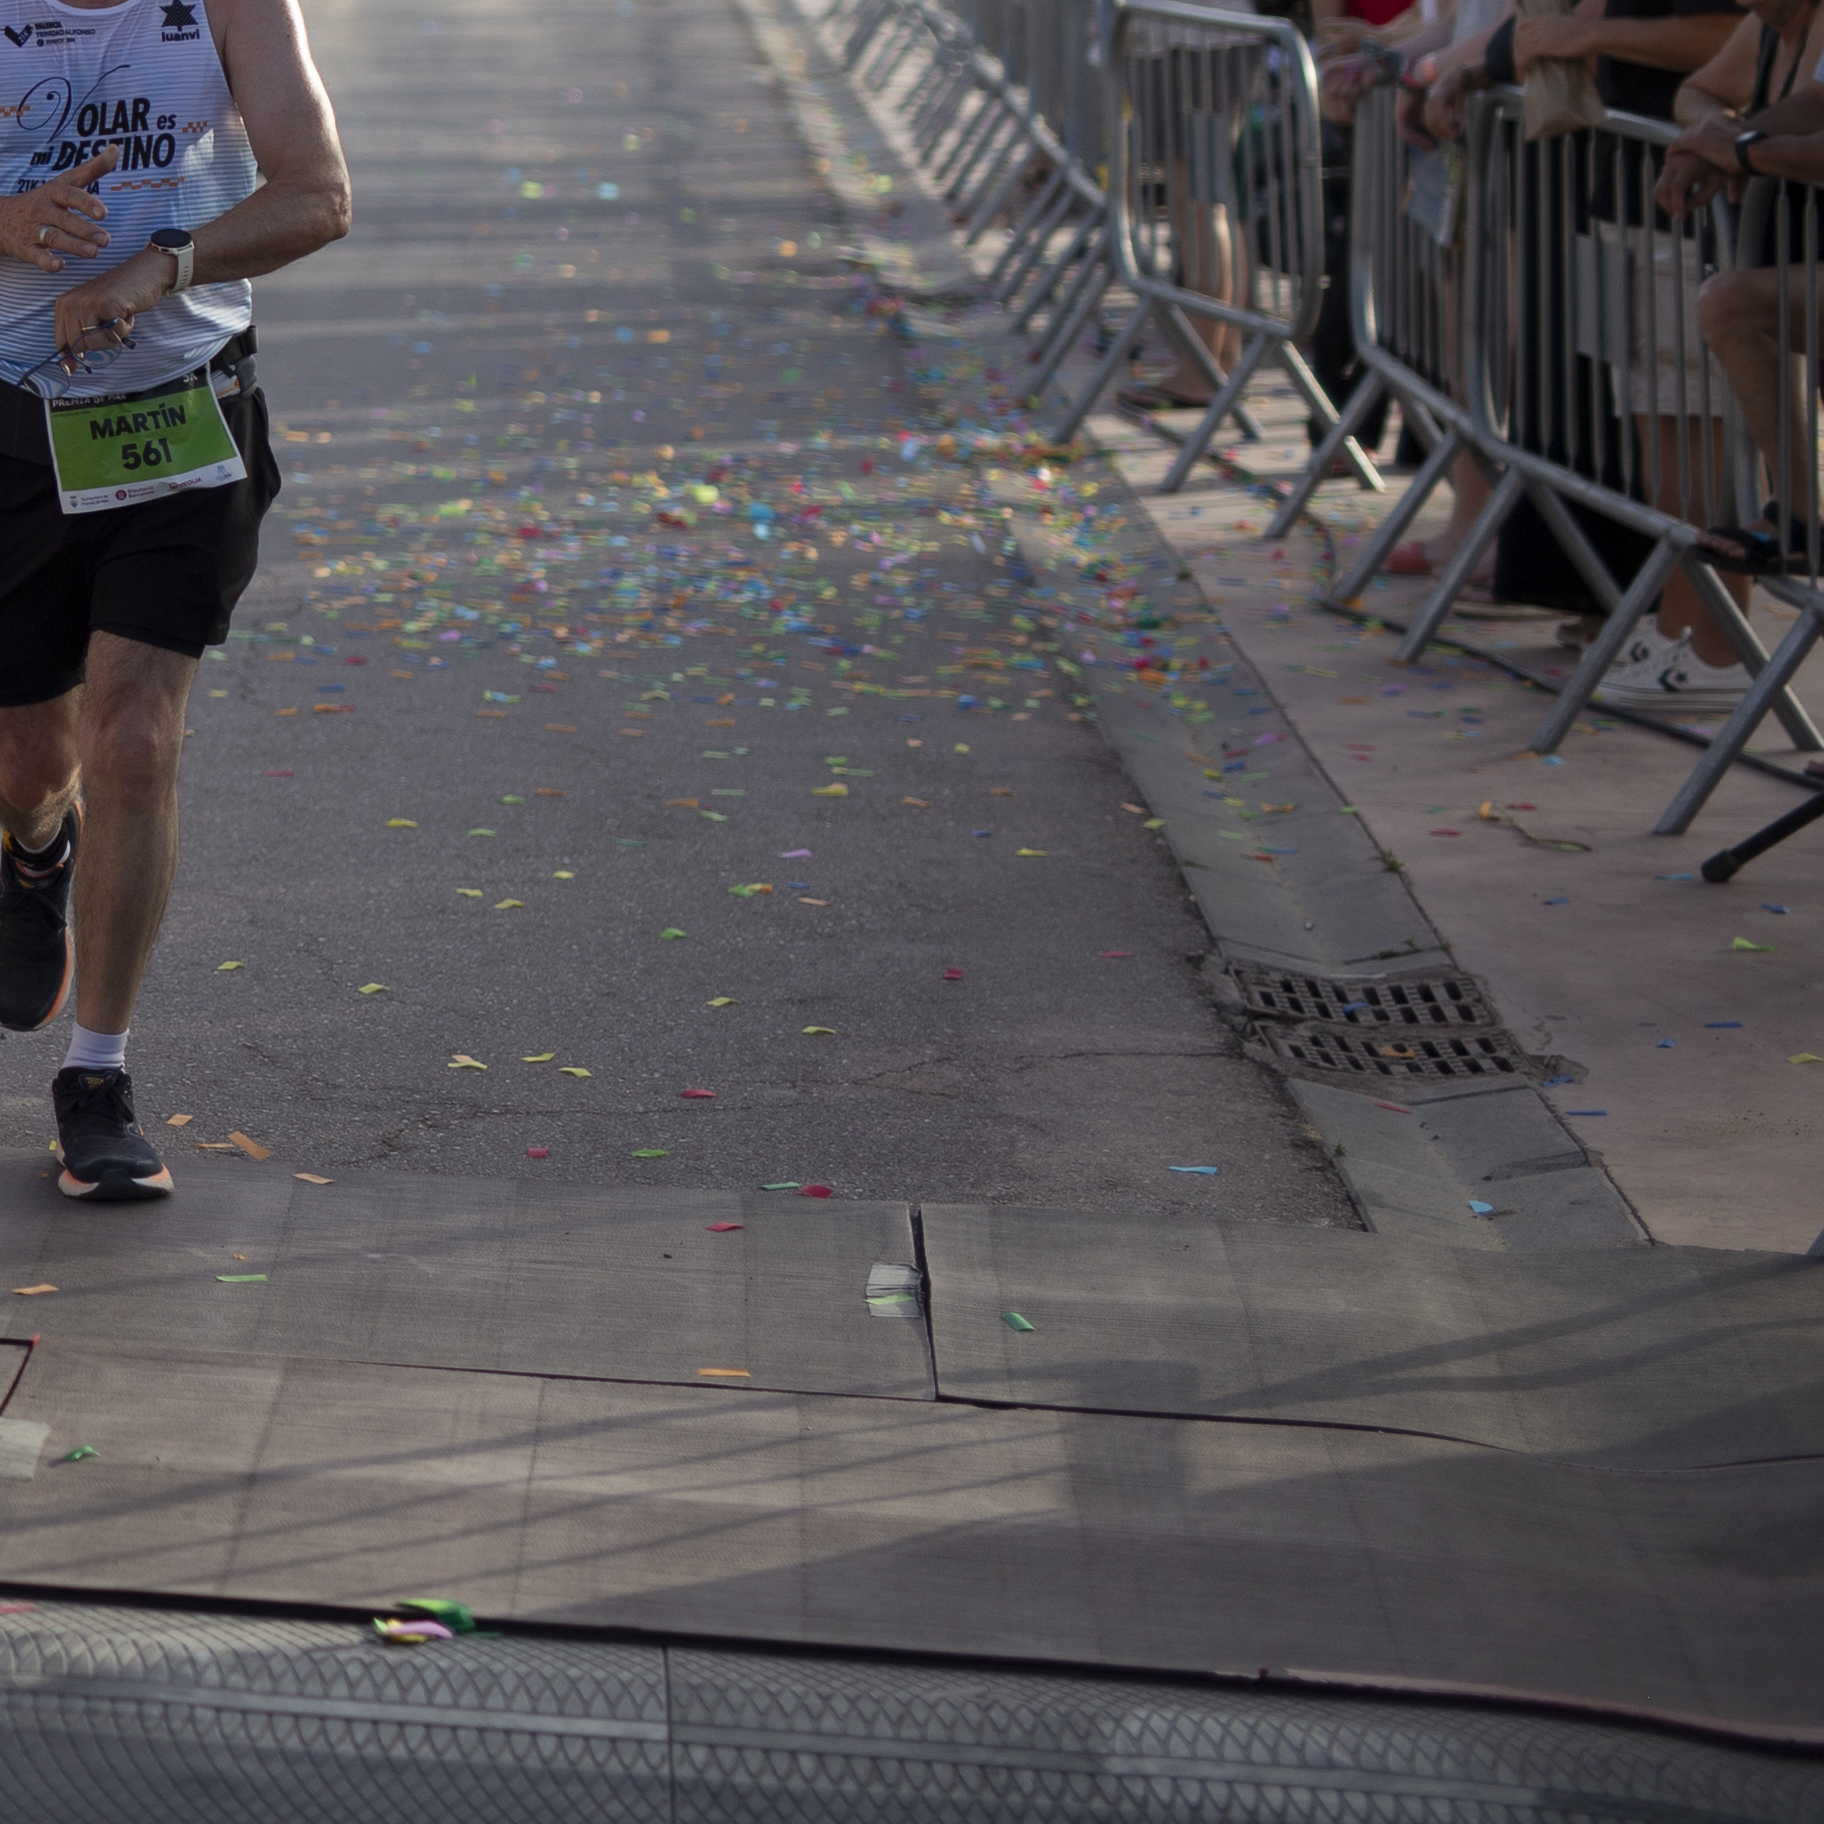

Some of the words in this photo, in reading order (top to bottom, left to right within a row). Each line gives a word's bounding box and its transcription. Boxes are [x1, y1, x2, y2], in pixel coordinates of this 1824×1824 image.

[156, 113, 178, 130] es
[29, 146, 55, 166] mi
[89, 402, 187, 441] MARTÍN
[121, 437, 173, 470] 561
